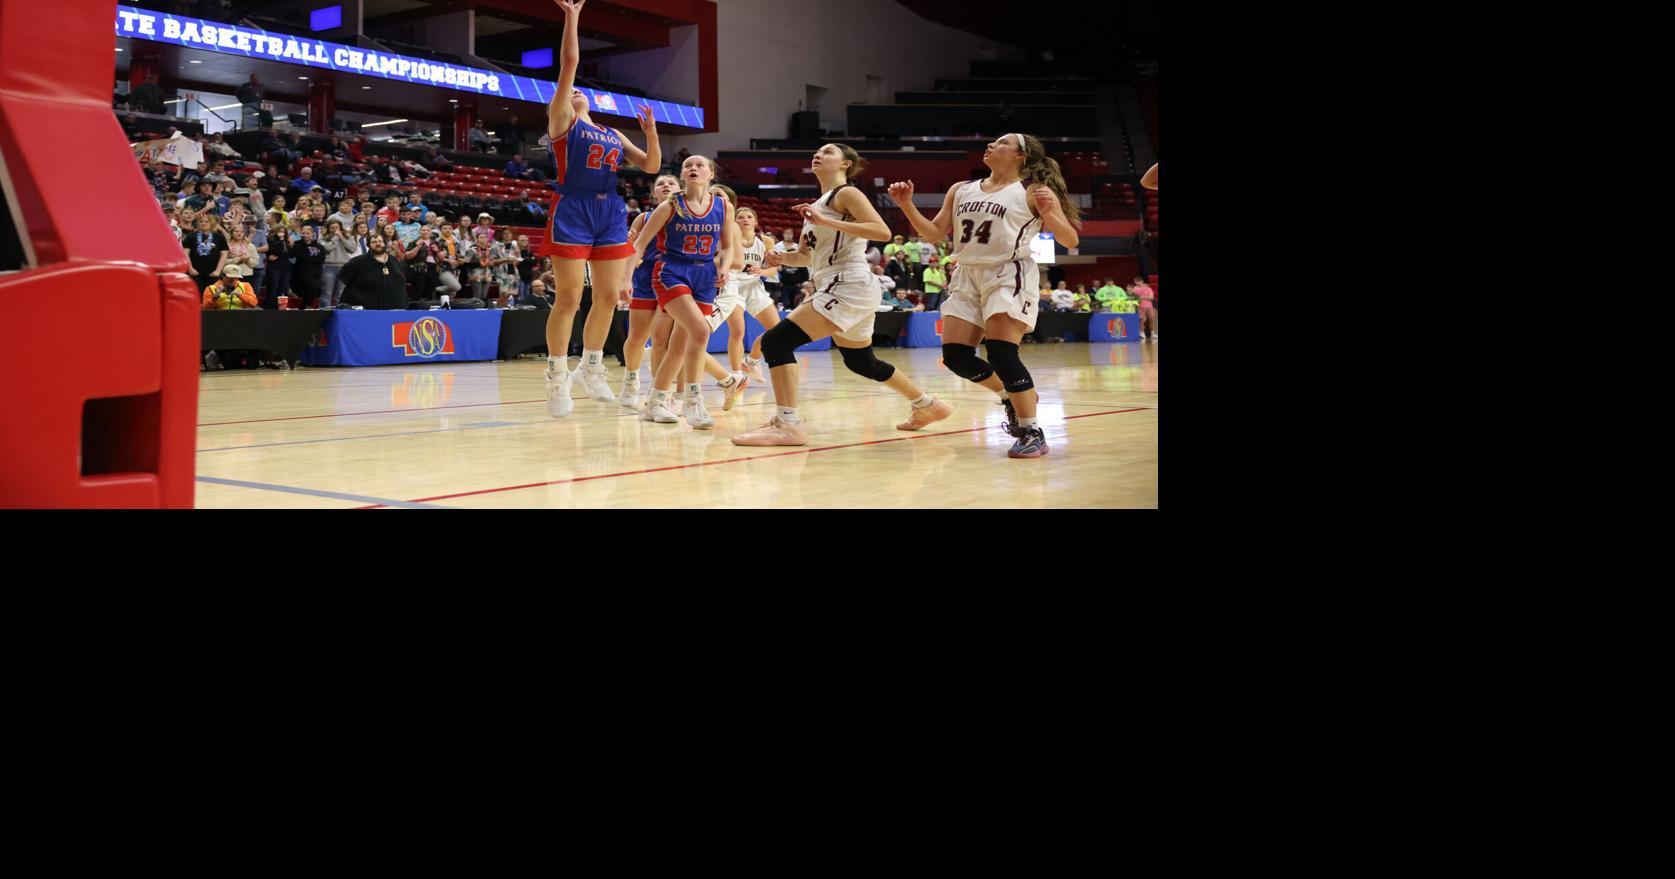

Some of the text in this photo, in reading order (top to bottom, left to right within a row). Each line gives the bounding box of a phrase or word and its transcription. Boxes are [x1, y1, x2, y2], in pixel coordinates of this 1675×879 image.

[115, 11, 500, 92] TE BASKETBALL CHAMPIONSHIPS
[586, 144, 620, 172] 24
[956, 201, 1007, 219] CROFTON
[960, 219, 993, 245] 34
[682, 235, 714, 255] 23
[824, 298, 839, 310] C
[1021, 300, 1031, 315] C
